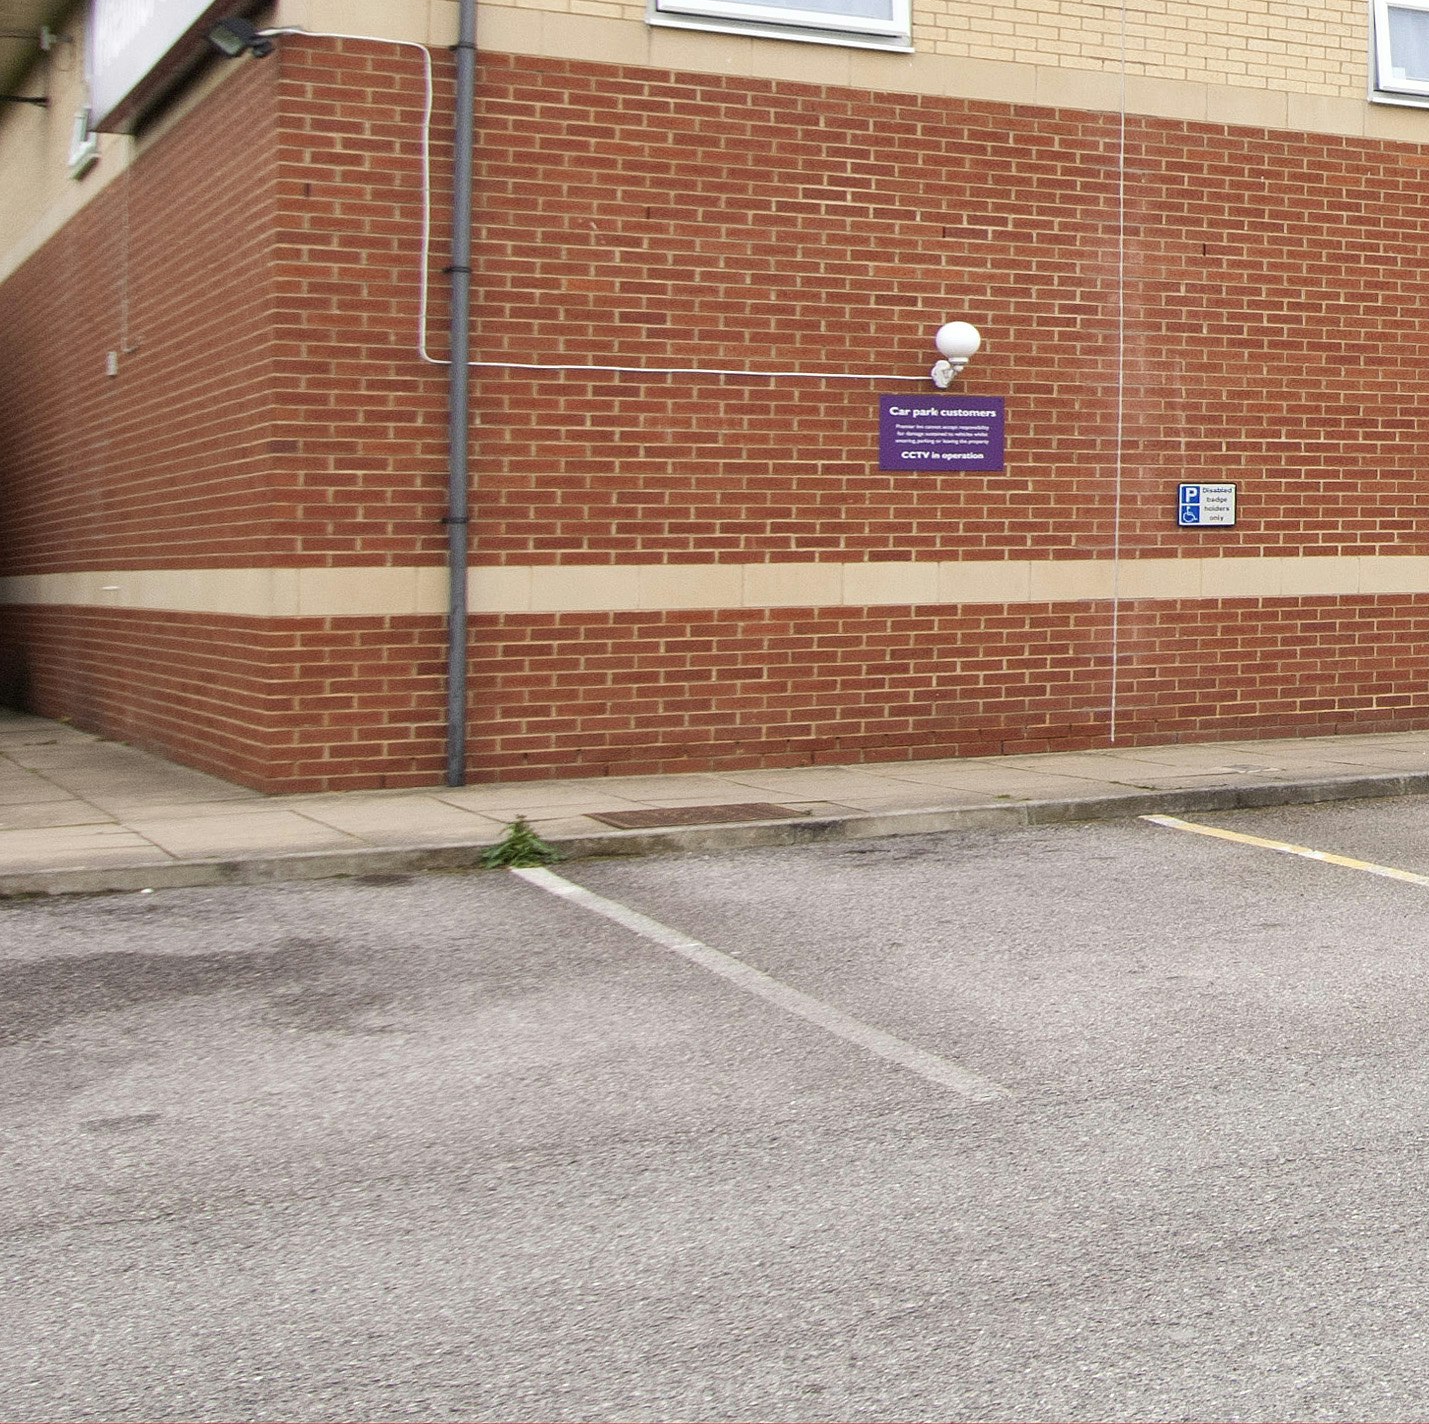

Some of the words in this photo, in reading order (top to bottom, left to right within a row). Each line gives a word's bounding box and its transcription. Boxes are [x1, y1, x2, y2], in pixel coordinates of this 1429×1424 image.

[889, 406, 911, 416] Car
[913, 407, 939, 418] park
[940, 409, 997, 417] customers
[901, 451, 930, 459] CCTV
[931, 451, 941, 459] in
[941, 451, 984, 461] operation
